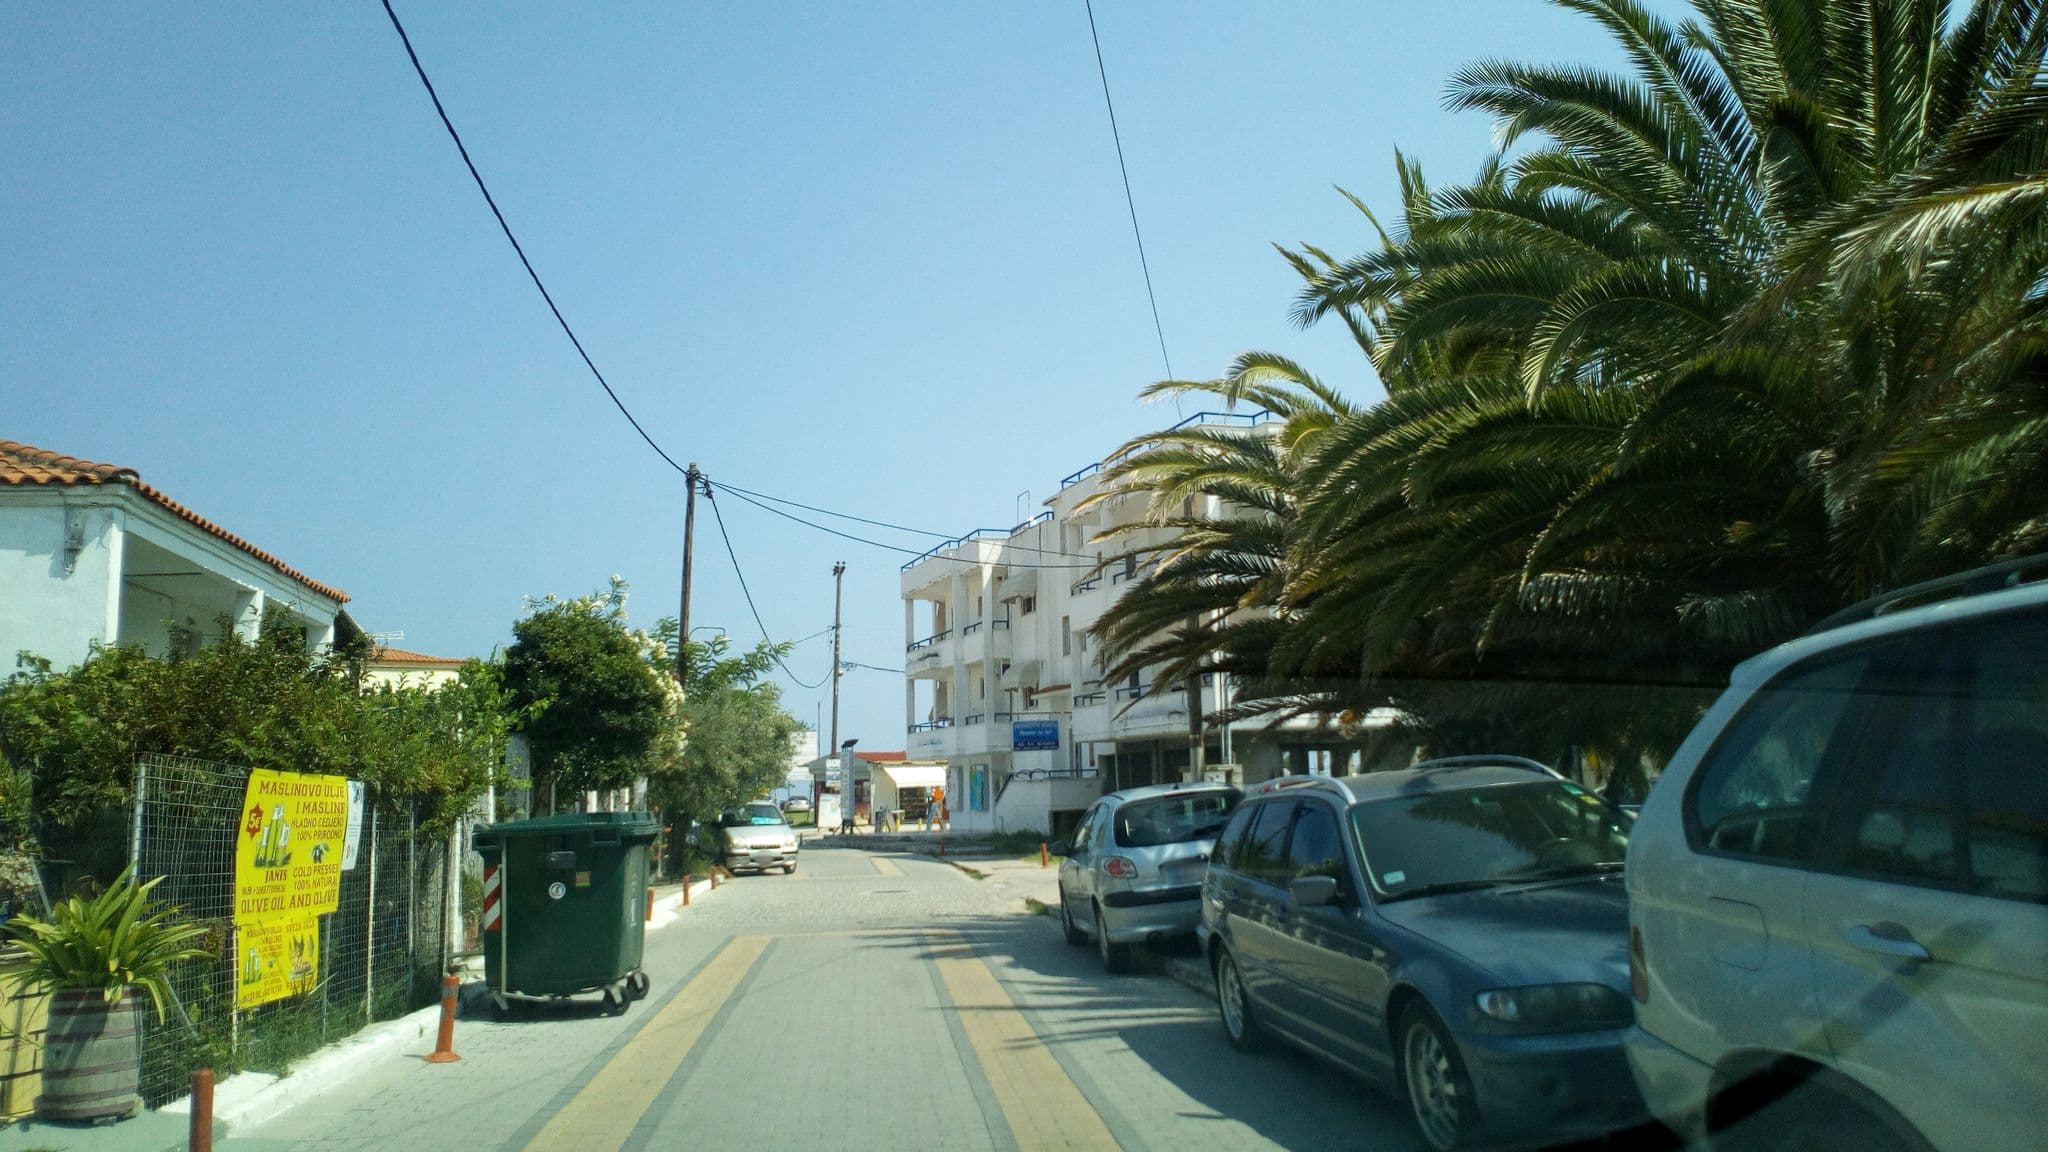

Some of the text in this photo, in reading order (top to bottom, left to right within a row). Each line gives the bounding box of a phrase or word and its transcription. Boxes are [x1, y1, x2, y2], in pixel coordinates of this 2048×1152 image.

[260, 781, 344, 798] MASLINOVO ULJE
[296, 801, 345, 815] I MASLINE
[248, 813, 262, 828] 5€
[293, 866, 312, 878] COLD
[294, 879, 311, 891] 100%
[241, 897, 269, 914] OLIVE
[272, 897, 285, 910] OIL
[289, 893, 311, 909] AND
